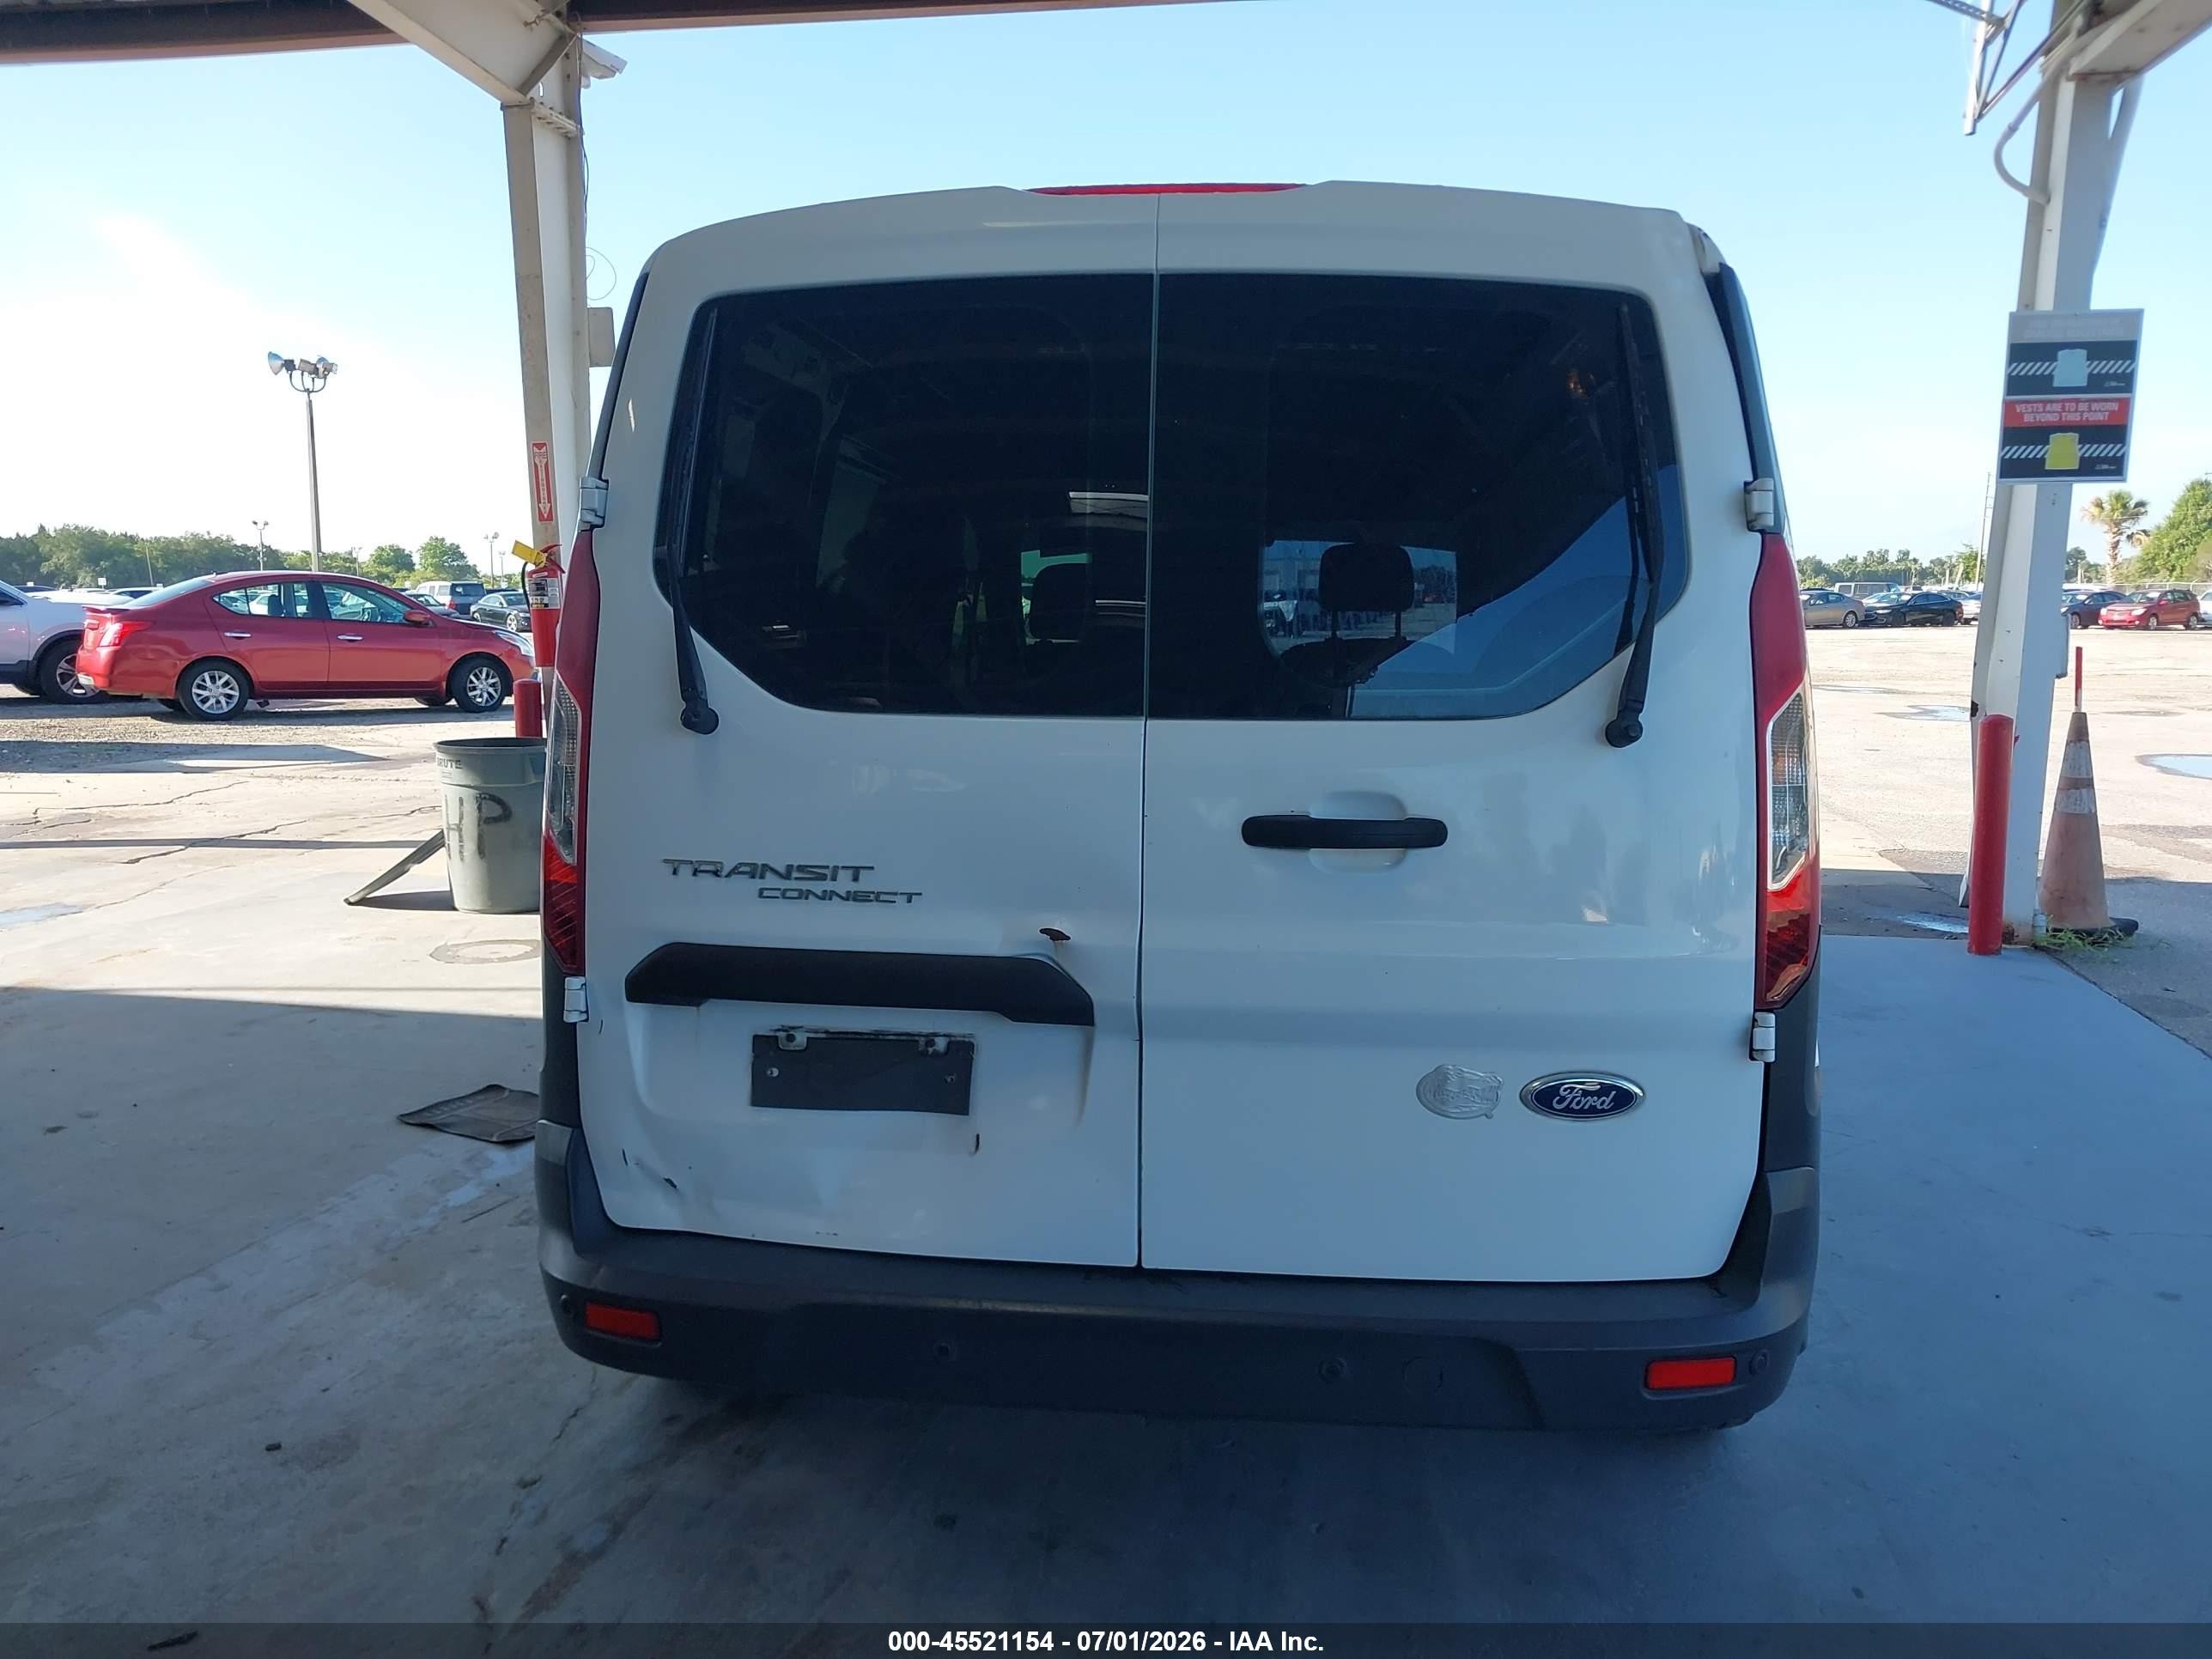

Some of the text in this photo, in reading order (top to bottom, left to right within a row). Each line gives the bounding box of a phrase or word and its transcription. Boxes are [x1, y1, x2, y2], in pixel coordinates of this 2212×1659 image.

[2015, 402, 2118, 413] VESTS ARE TO BE WORN
[2024, 411, 2110, 422] BEYOND THIS POINT
[661, 859, 875, 883] TRANSIT
[758, 888, 922, 904] CONNECT
[1553, 1082, 1616, 1110] Ford
